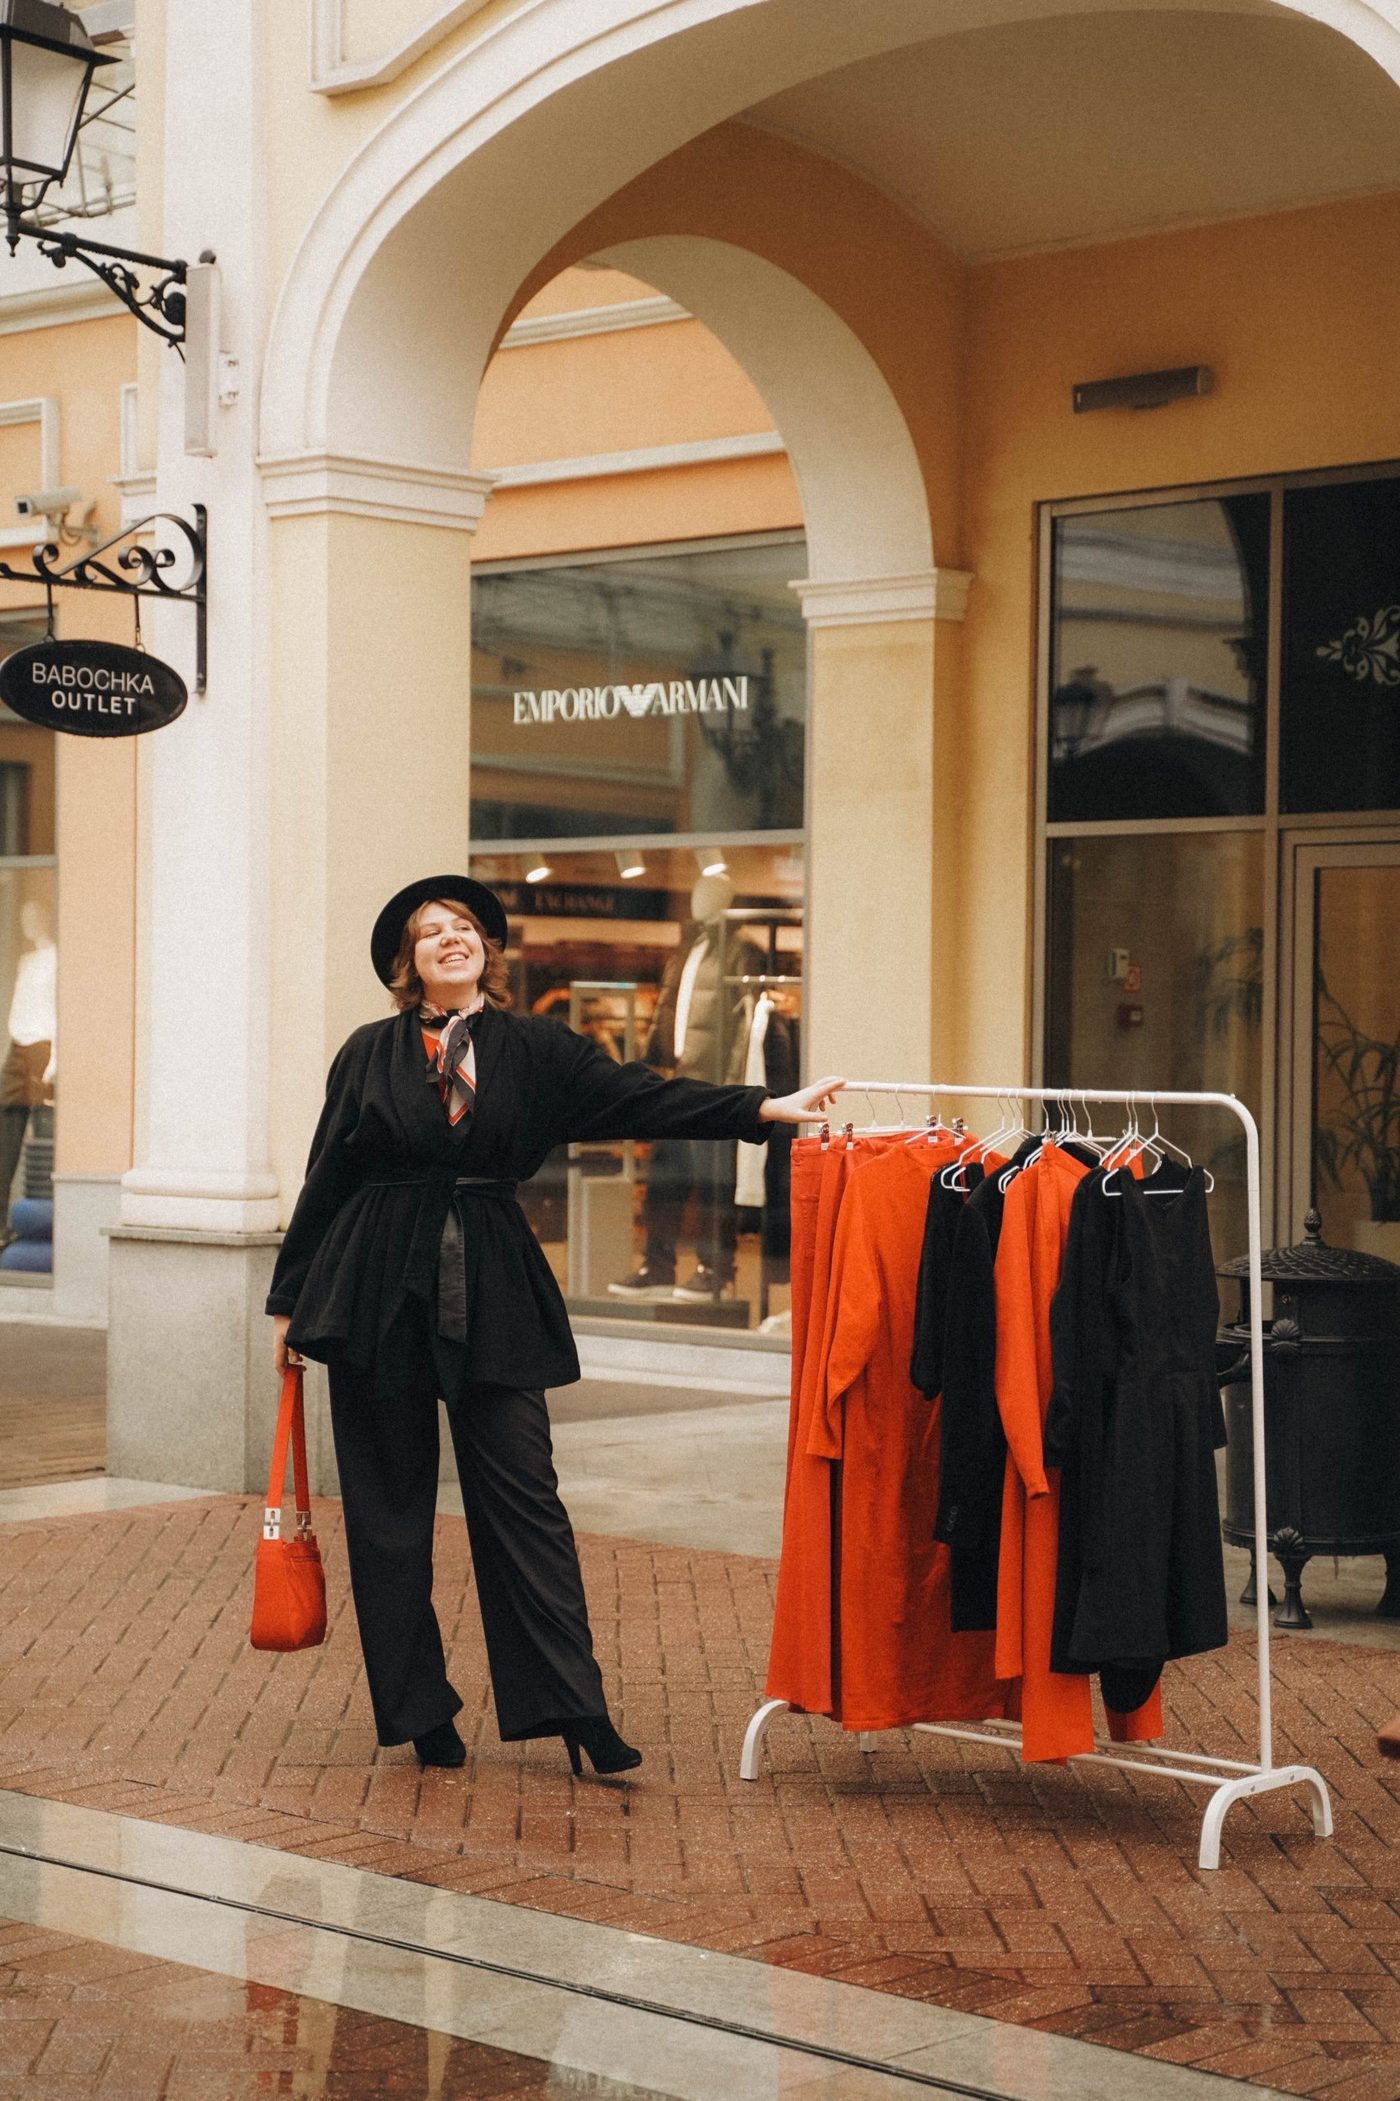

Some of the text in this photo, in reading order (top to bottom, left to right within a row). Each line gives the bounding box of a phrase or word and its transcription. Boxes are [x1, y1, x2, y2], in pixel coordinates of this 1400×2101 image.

[32, 662, 155, 695] BABOCHKA
[51, 690, 136, 715] OUTLET
[513, 675, 748, 724] EMPORIO ARMANI
